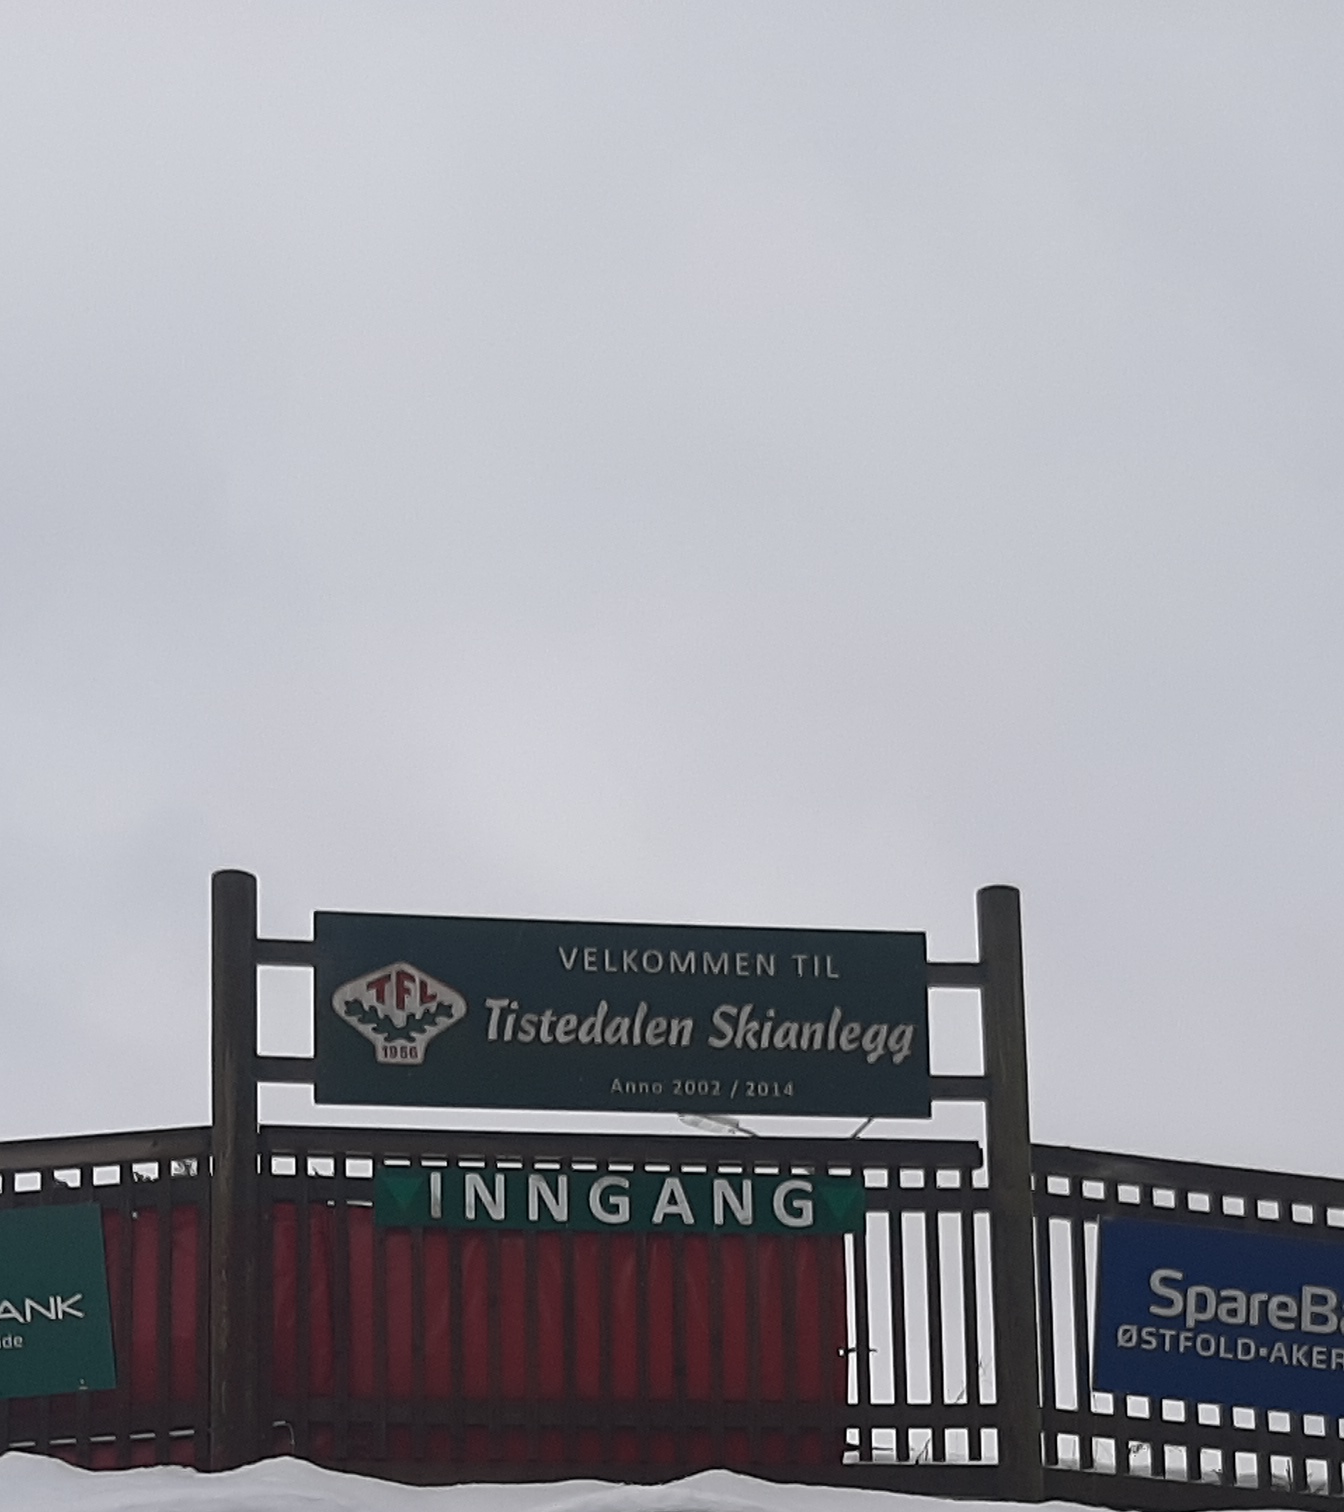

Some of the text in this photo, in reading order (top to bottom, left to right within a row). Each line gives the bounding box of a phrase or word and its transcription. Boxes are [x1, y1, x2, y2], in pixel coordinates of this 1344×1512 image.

[559, 946, 839, 979] VELKOMMEN TIL
[367, 969, 437, 1011] TFL
[484, 998, 914, 1063] Tistedalen Skianlegg
[610, 1077, 795, 1100] Anno 2002 / 2014
[428, 1171, 814, 1228] INNGANG
